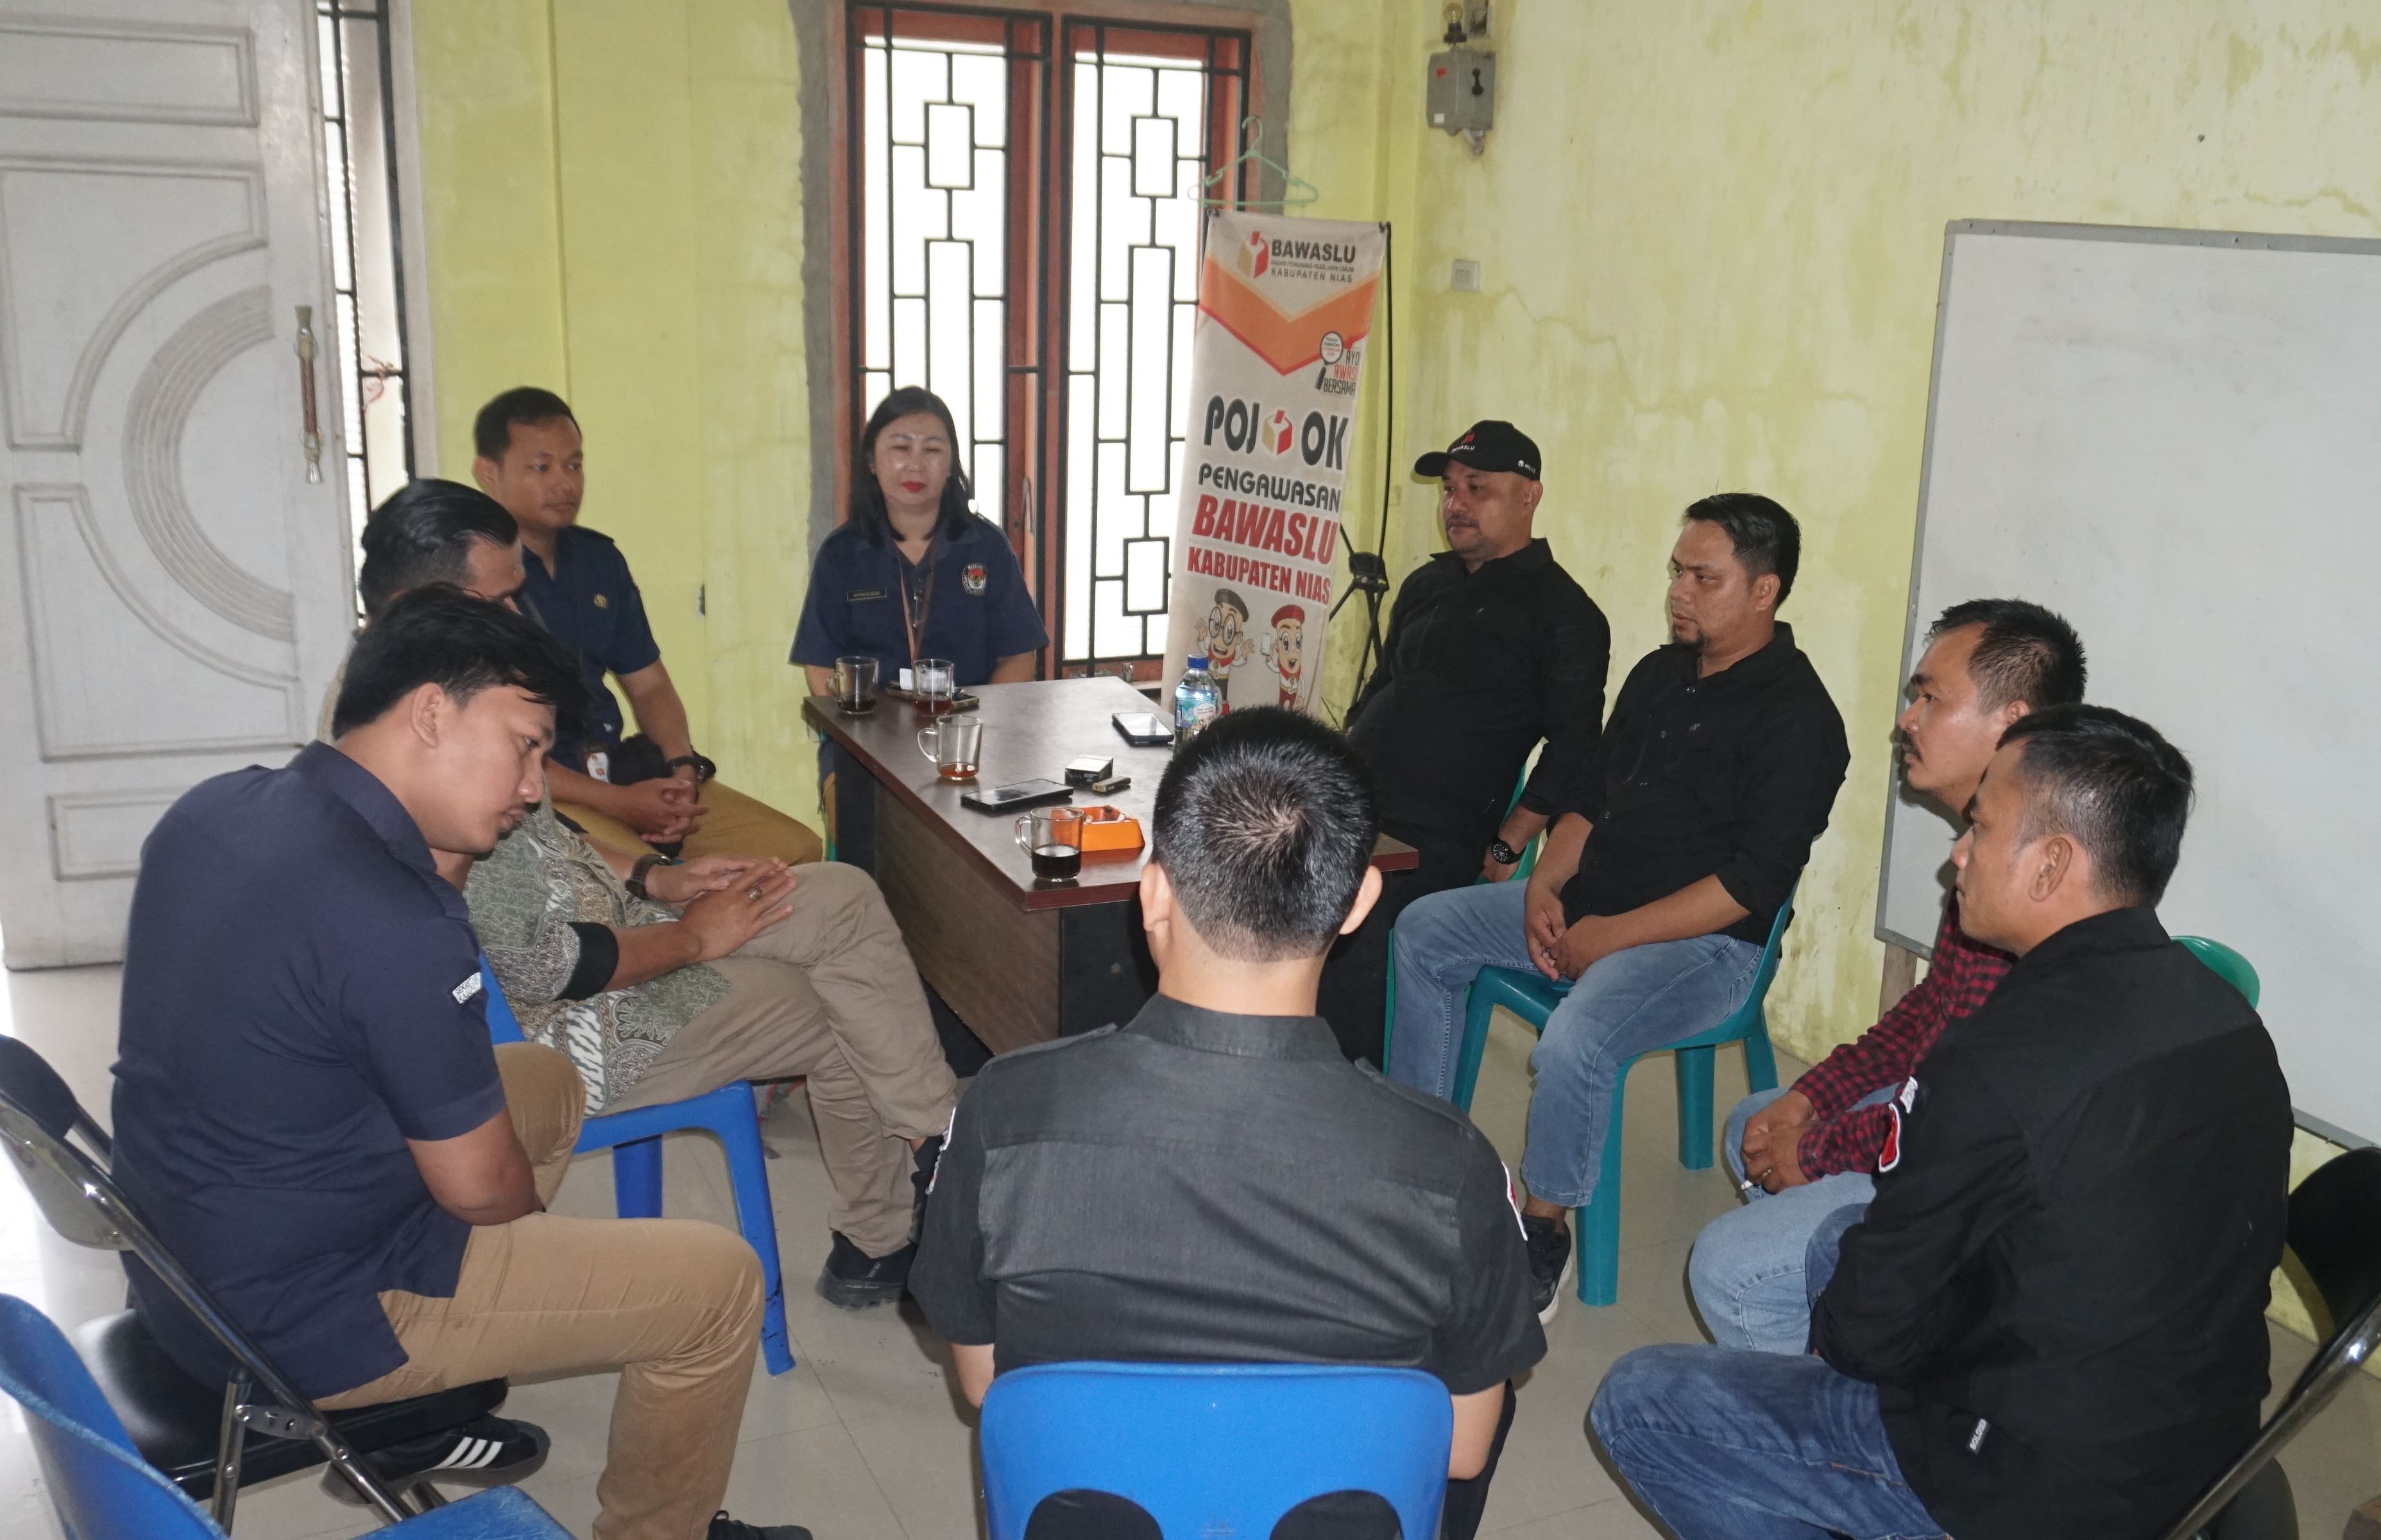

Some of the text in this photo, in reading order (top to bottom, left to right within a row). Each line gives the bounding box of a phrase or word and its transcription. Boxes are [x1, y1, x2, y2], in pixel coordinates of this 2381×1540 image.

[1271, 239, 1356, 263] BAWASLU
[1270, 268, 1353, 284] KABUPATEN NIAS
[1345, 350, 1360, 366] AYO
[1333, 364, 1359, 381] AWASI
[1323, 377, 1356, 397] BERSAMA
[1301, 411, 1349, 471] OK
[1198, 463, 1341, 513] PENGAWASAN
[1191, 493, 1338, 565] BAWASLU
[1187, 545, 1331, 606] KABUPATEN NIAS
